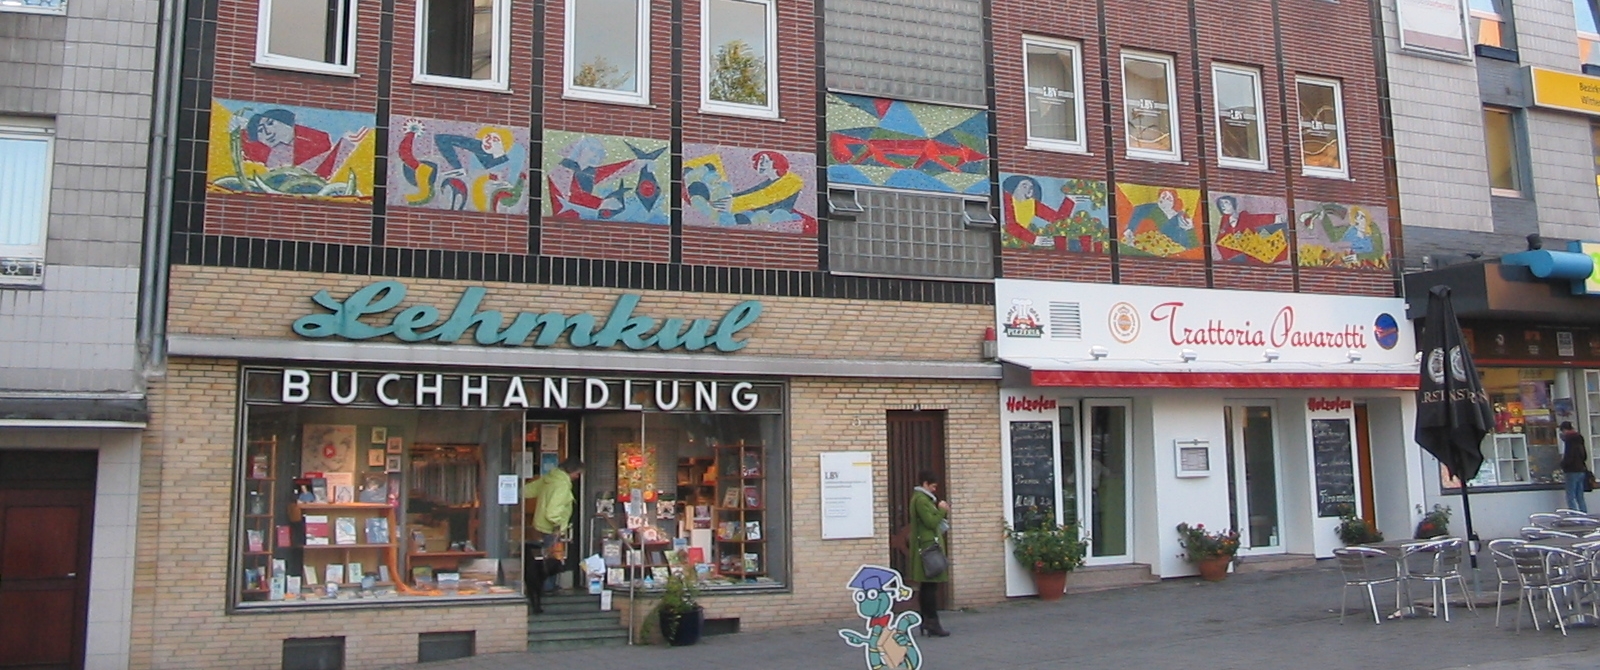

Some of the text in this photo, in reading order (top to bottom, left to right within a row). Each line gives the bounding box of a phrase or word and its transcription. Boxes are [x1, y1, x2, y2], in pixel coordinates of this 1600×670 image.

[292, 280, 763, 352] Lehmkul
[1150, 301, 1266, 347] Trattoria
[1270, 305, 1367, 348] Pavarotti
[1007, 327, 1041, 337] PIZZERIA
[282, 369, 759, 412] BUCHHANDLUNG
[1006, 395, 1056, 413] Holzofen
[1308, 396, 1352, 413] Holzofen
